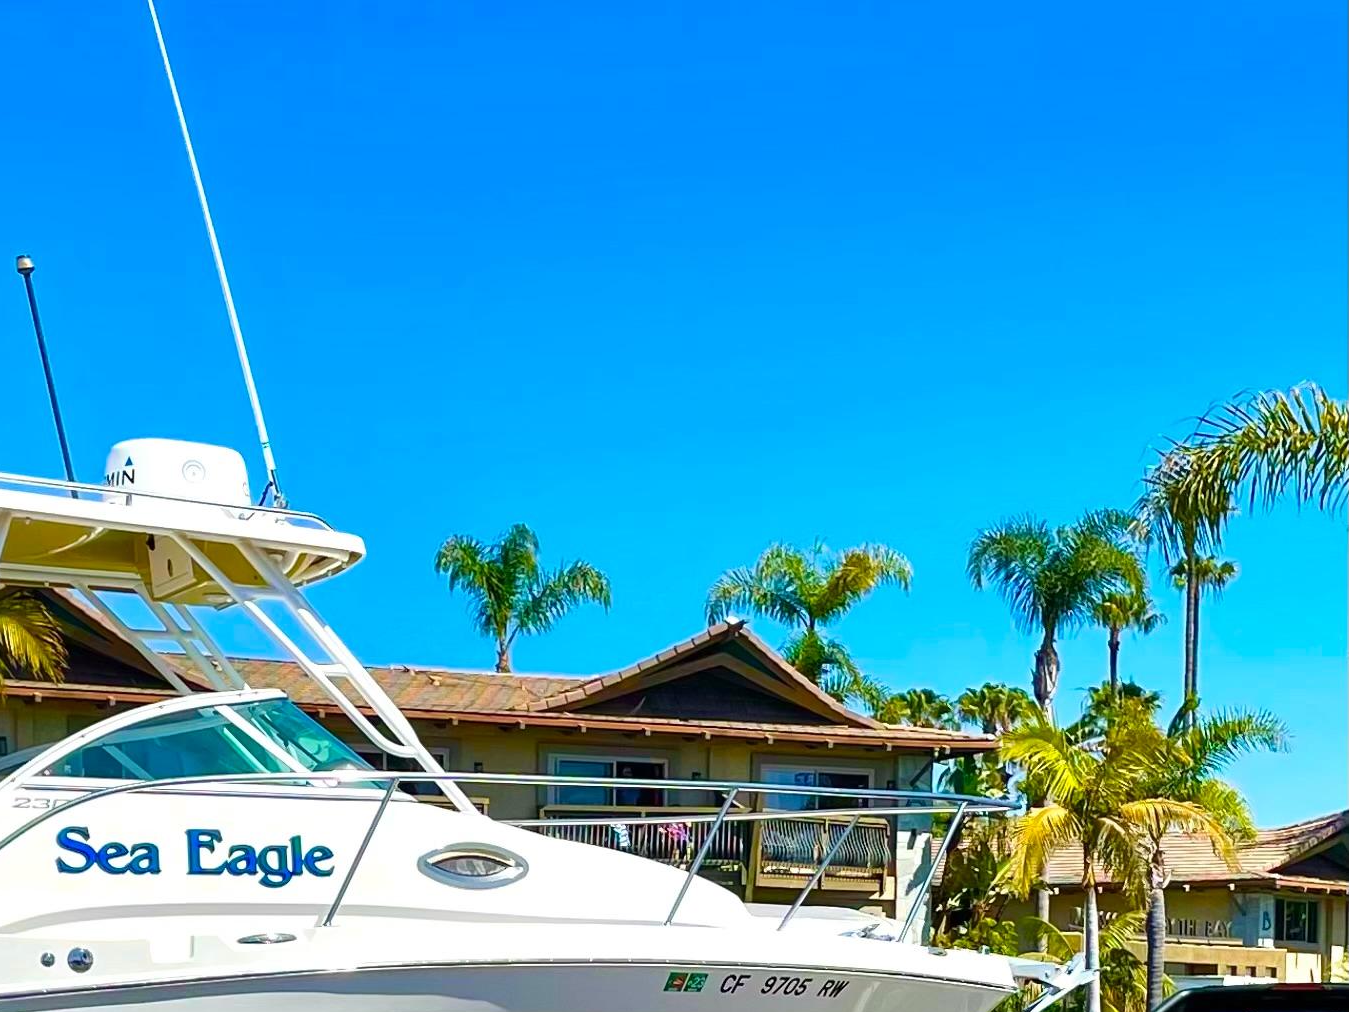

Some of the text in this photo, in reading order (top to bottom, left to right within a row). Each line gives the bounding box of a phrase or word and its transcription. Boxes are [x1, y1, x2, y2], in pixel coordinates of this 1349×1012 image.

[55, 826, 336, 889] Sea Eagle
[1204, 919, 1233, 937] BAY
[720, 974, 850, 998] CF 9705 RW
